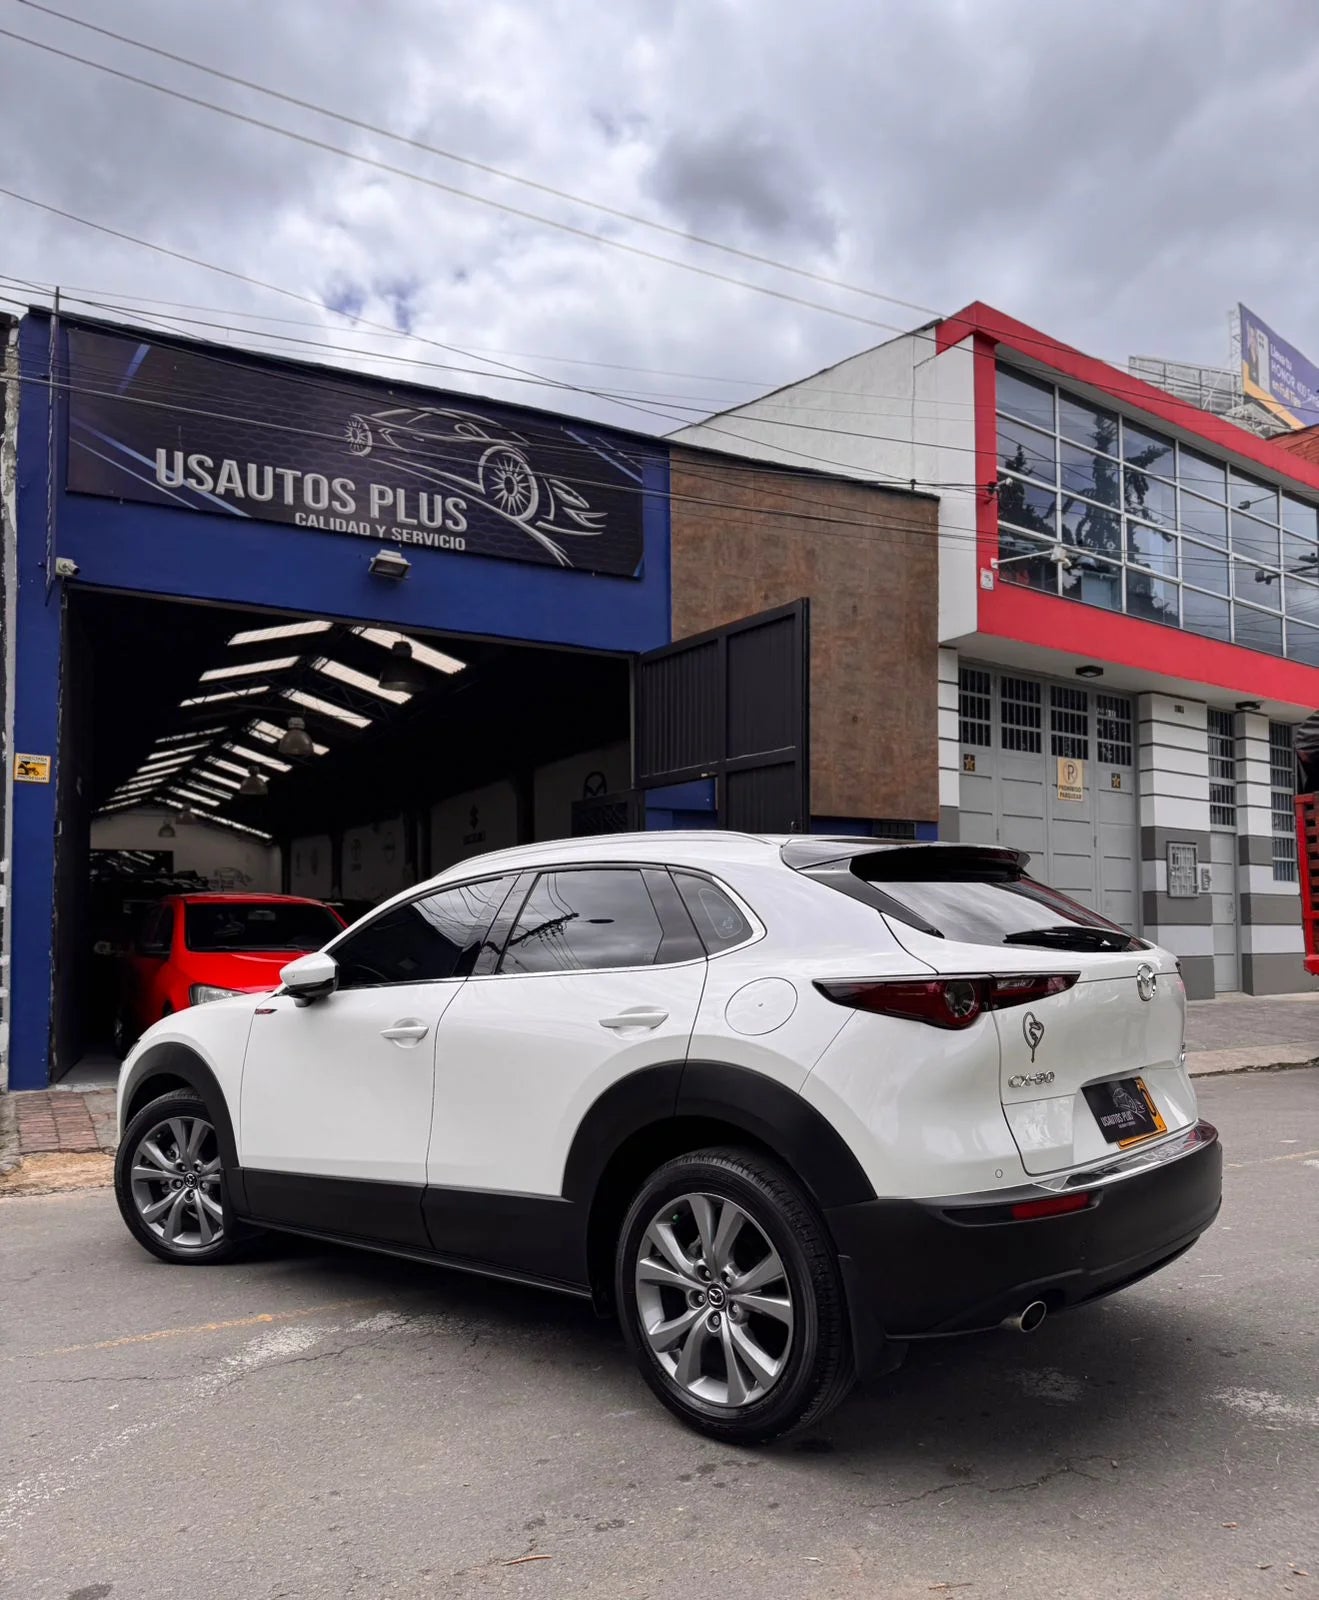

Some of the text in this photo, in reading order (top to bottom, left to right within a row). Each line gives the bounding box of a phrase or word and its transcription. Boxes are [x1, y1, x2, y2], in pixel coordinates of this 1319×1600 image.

[155, 448, 468, 533] USAUTOS PLUS
[294, 511, 467, 551] CALIDAD Y SERVICIO
[1007, 1070, 1055, 1089] CX-30
